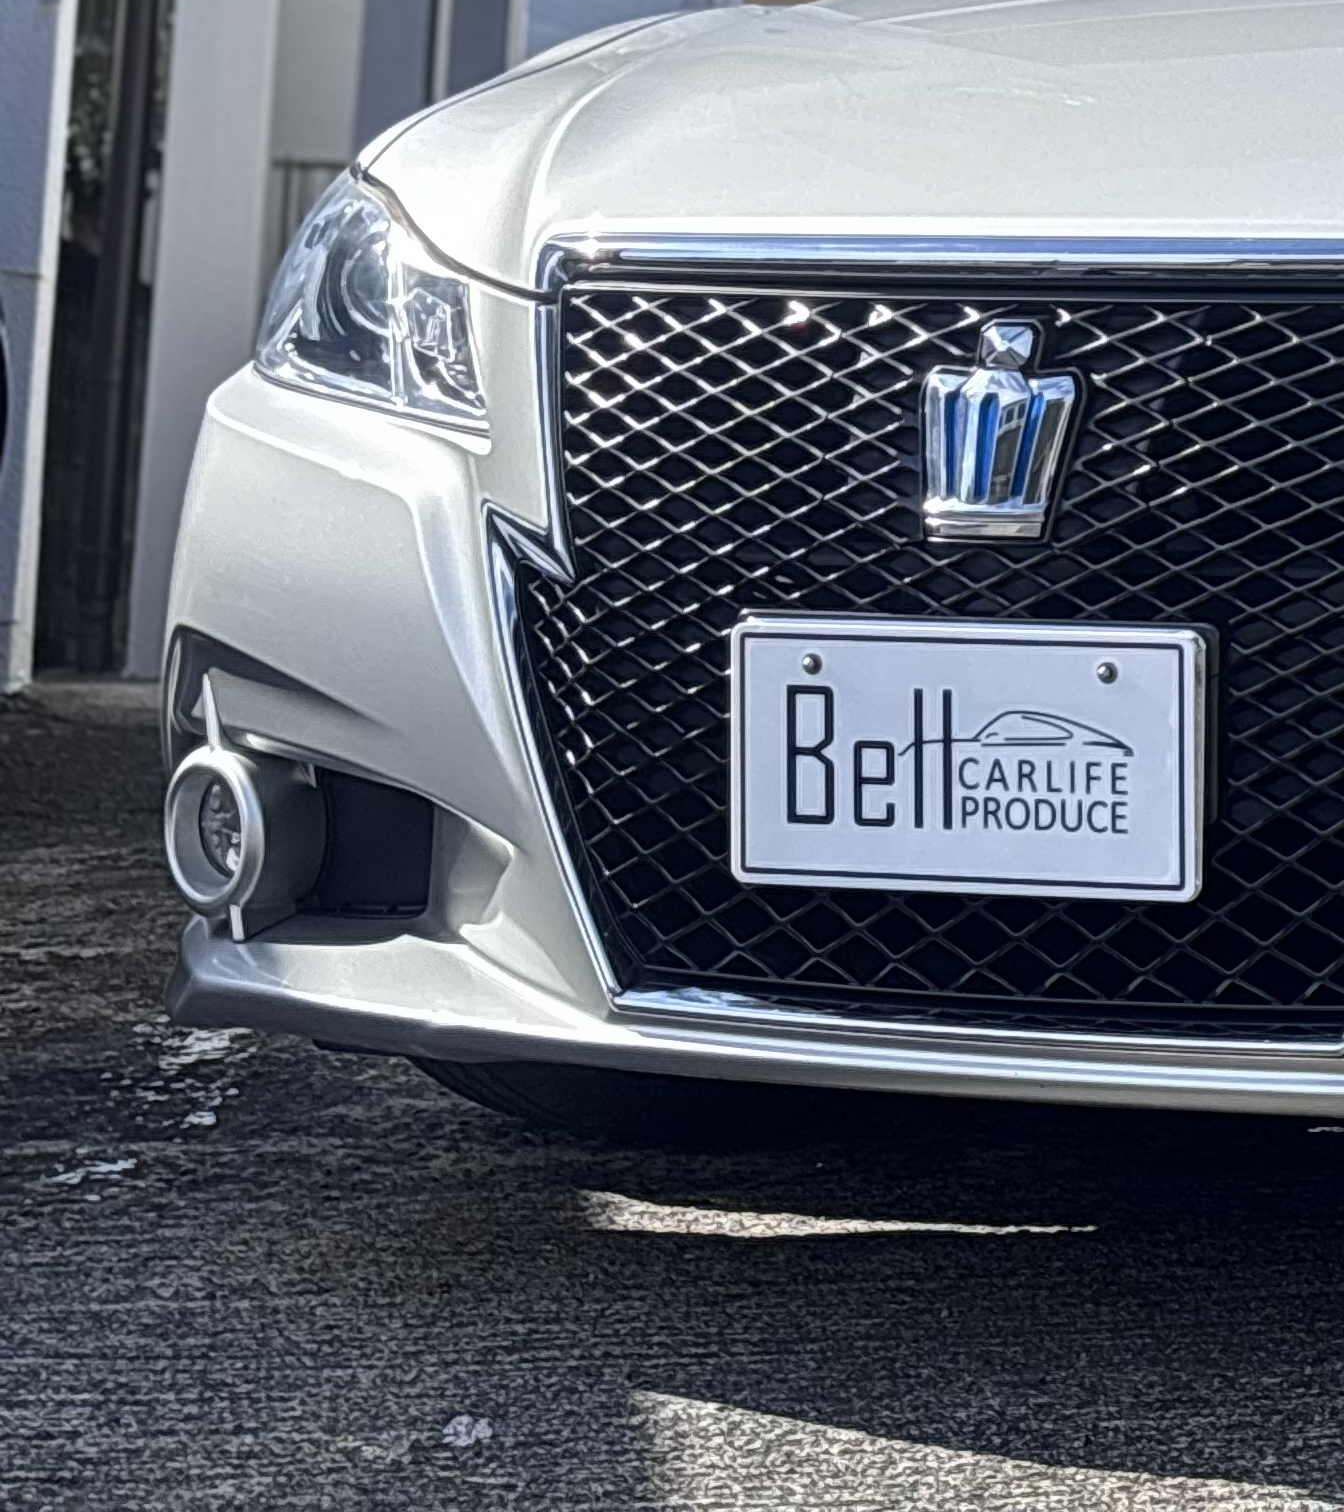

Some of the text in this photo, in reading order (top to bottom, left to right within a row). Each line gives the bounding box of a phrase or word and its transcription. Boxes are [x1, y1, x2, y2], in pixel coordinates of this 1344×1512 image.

[787, 684, 953, 831] Bell
[958, 756, 1129, 796] CARLIFE
[961, 795, 1129, 834] PRODUCE
